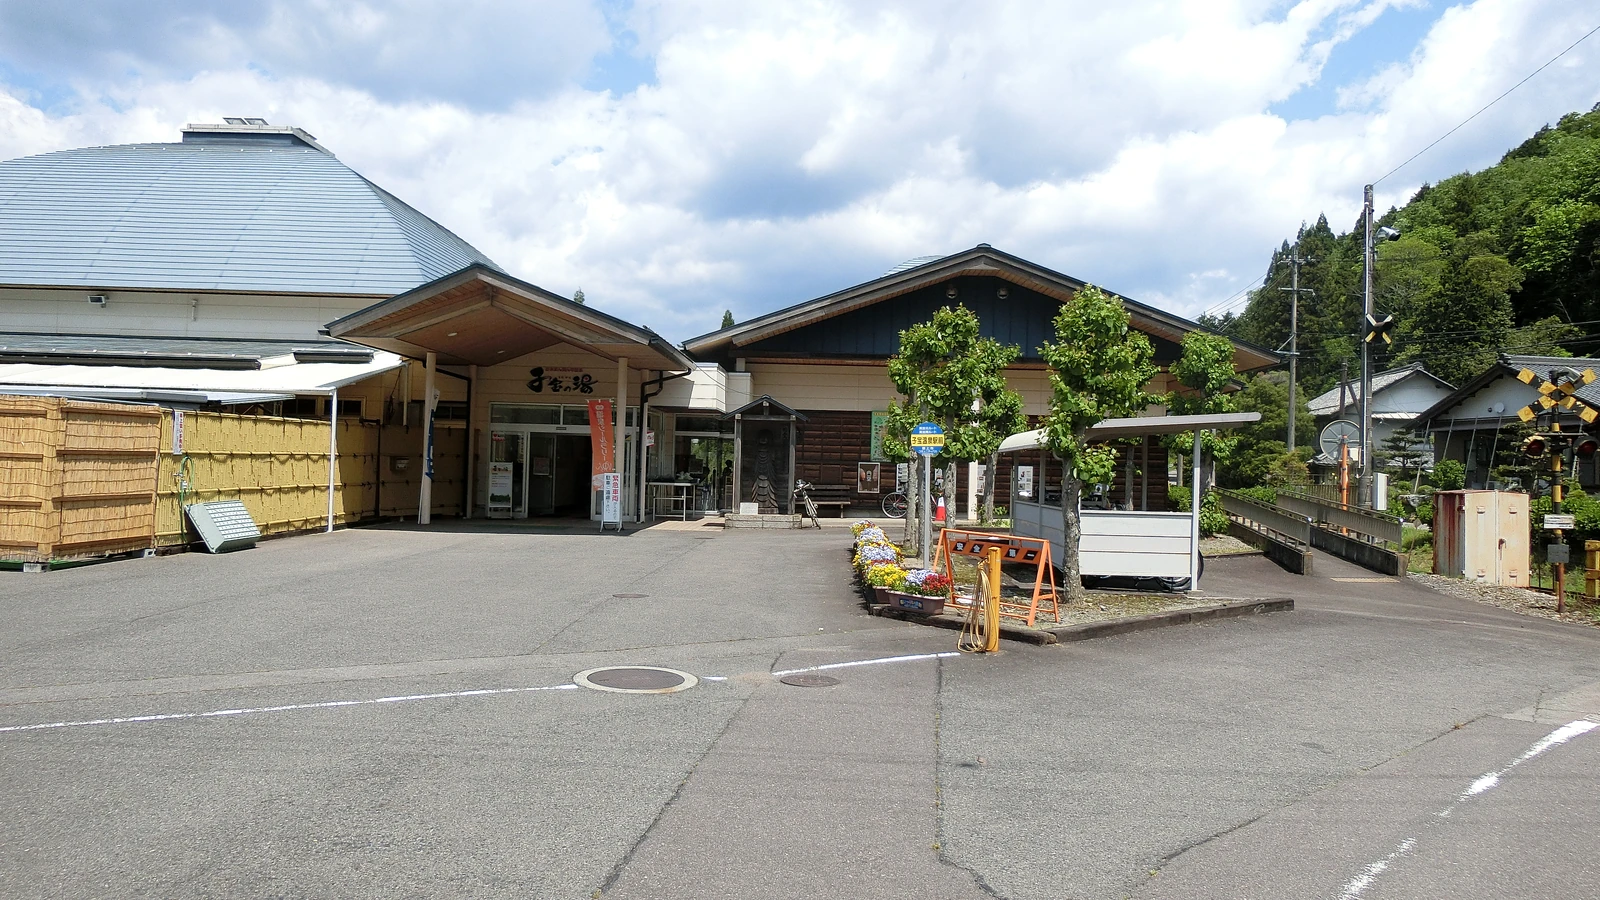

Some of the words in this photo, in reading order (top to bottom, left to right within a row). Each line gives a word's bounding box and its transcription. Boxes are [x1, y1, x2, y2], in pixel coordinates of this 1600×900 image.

[527, 367, 598, 394] 子宝の湯
[912, 436, 943, 445] 子宝温泉駅前
